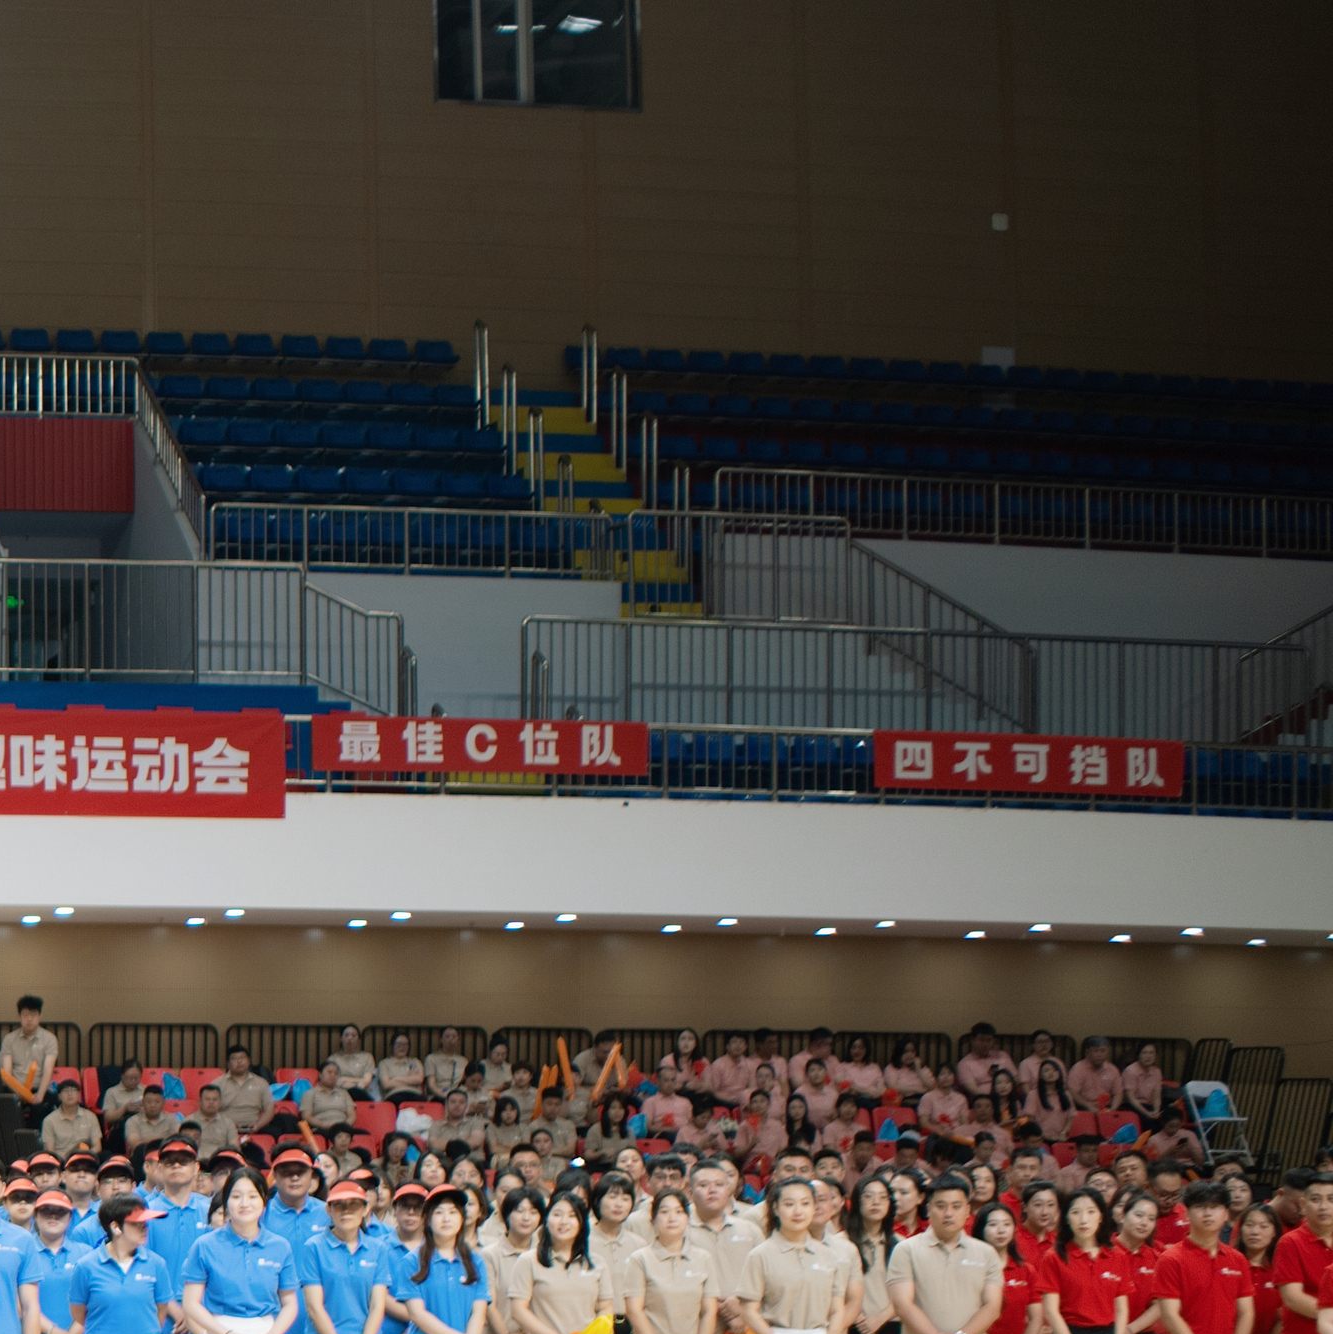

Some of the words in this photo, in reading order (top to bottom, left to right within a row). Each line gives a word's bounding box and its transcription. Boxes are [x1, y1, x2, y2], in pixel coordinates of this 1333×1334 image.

[338, 721, 621, 766] 最佳C位队
[894, 741, 1164, 787] 四不可挡队
